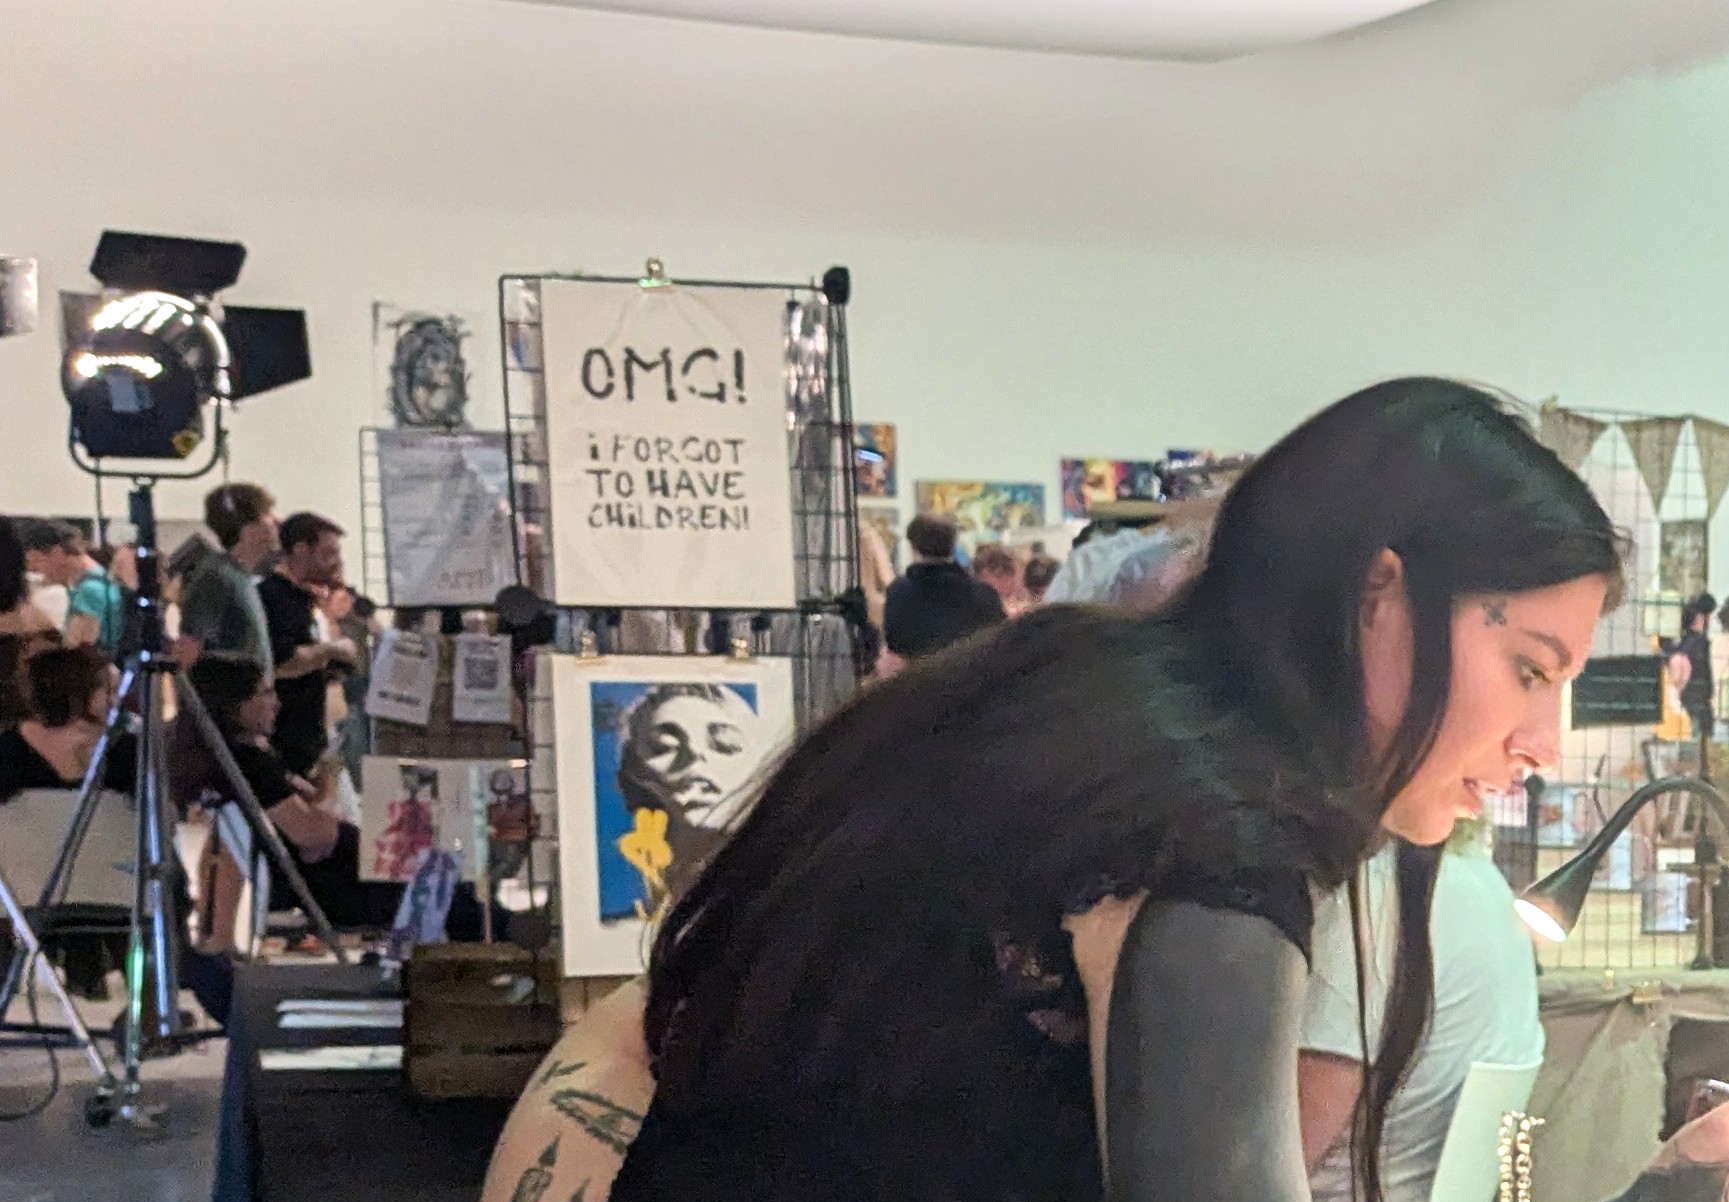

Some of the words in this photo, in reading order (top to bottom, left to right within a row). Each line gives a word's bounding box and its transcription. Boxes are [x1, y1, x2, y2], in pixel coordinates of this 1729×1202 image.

[581, 346, 747, 403] OMG!
[612, 434, 746, 464] FORGOT
[585, 468, 635, 499] TO
[646, 468, 746, 500] HAVE
